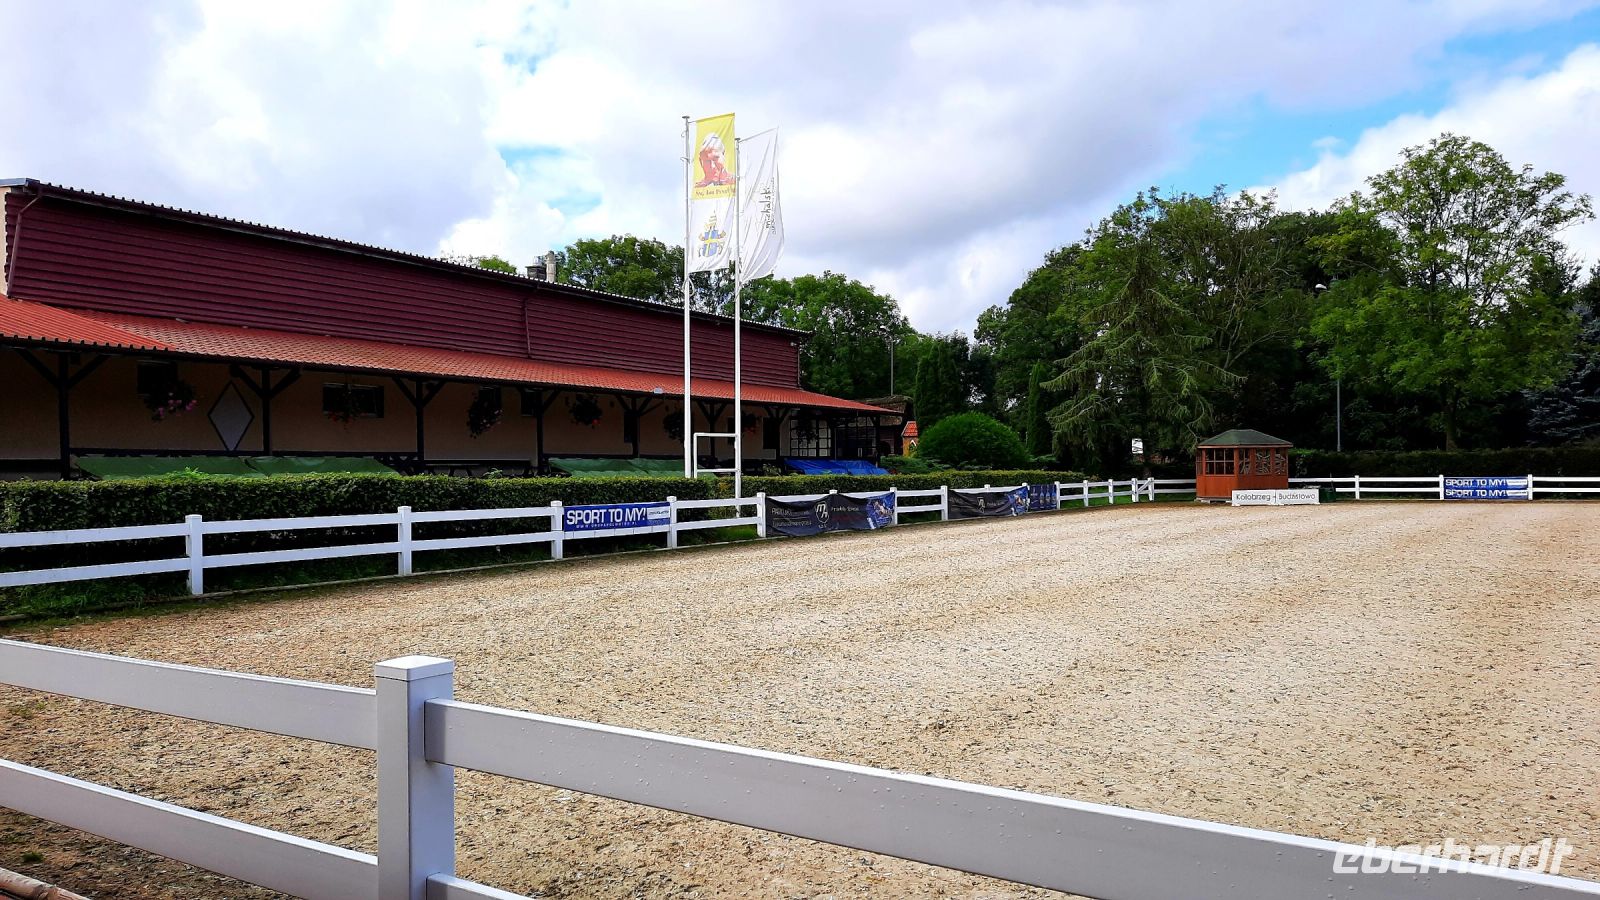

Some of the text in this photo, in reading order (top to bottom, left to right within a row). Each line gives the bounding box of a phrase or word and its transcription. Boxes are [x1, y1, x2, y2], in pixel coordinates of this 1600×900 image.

[566, 509, 606, 525] SPORT
[608, 508, 623, 523] TO
[625, 507, 647, 522] MY!
